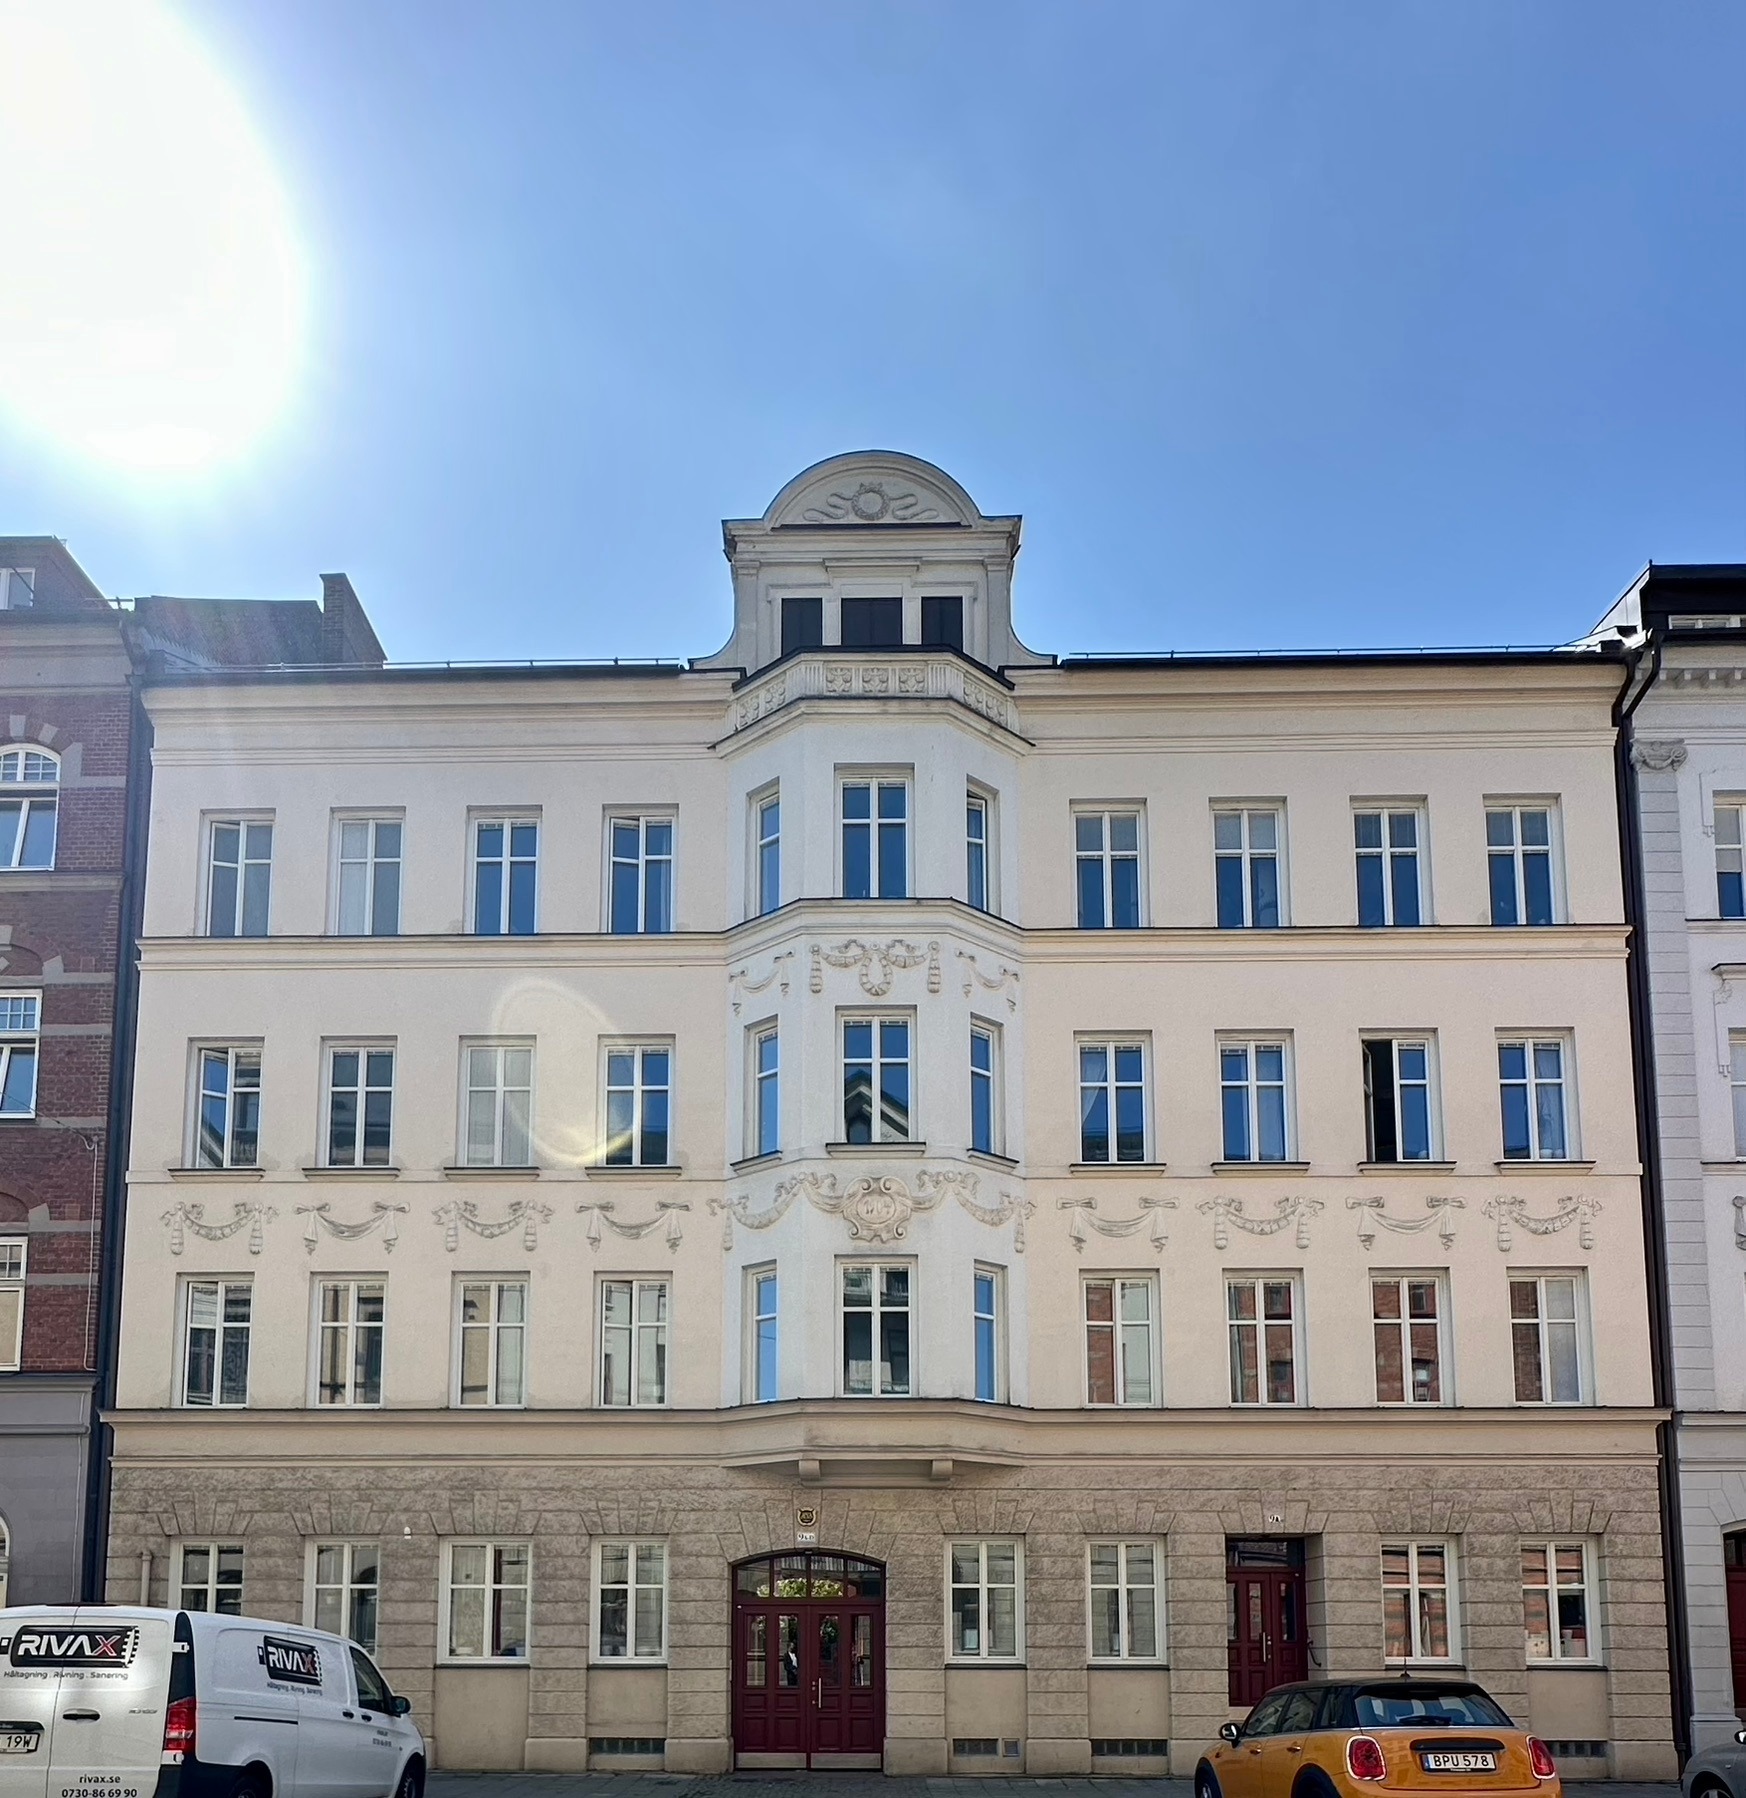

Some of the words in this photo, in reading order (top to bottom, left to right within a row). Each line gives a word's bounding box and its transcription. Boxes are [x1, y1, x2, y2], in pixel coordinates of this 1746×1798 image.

[18, 1635, 120, 1655] RIVAX
[268, 1646, 315, 1674] RIVAX
[7, 1735, 32, 1748] 19W
[1433, 1755, 1460, 1767] BPU
[1463, 1755, 1489, 1767] 578
[79, 1774, 121, 1784] rivax.se
[61, 1788, 106, 1798] 0730-86
[108, 1788, 121, 1798] 69
[123, 1788, 138, 1798] 90
